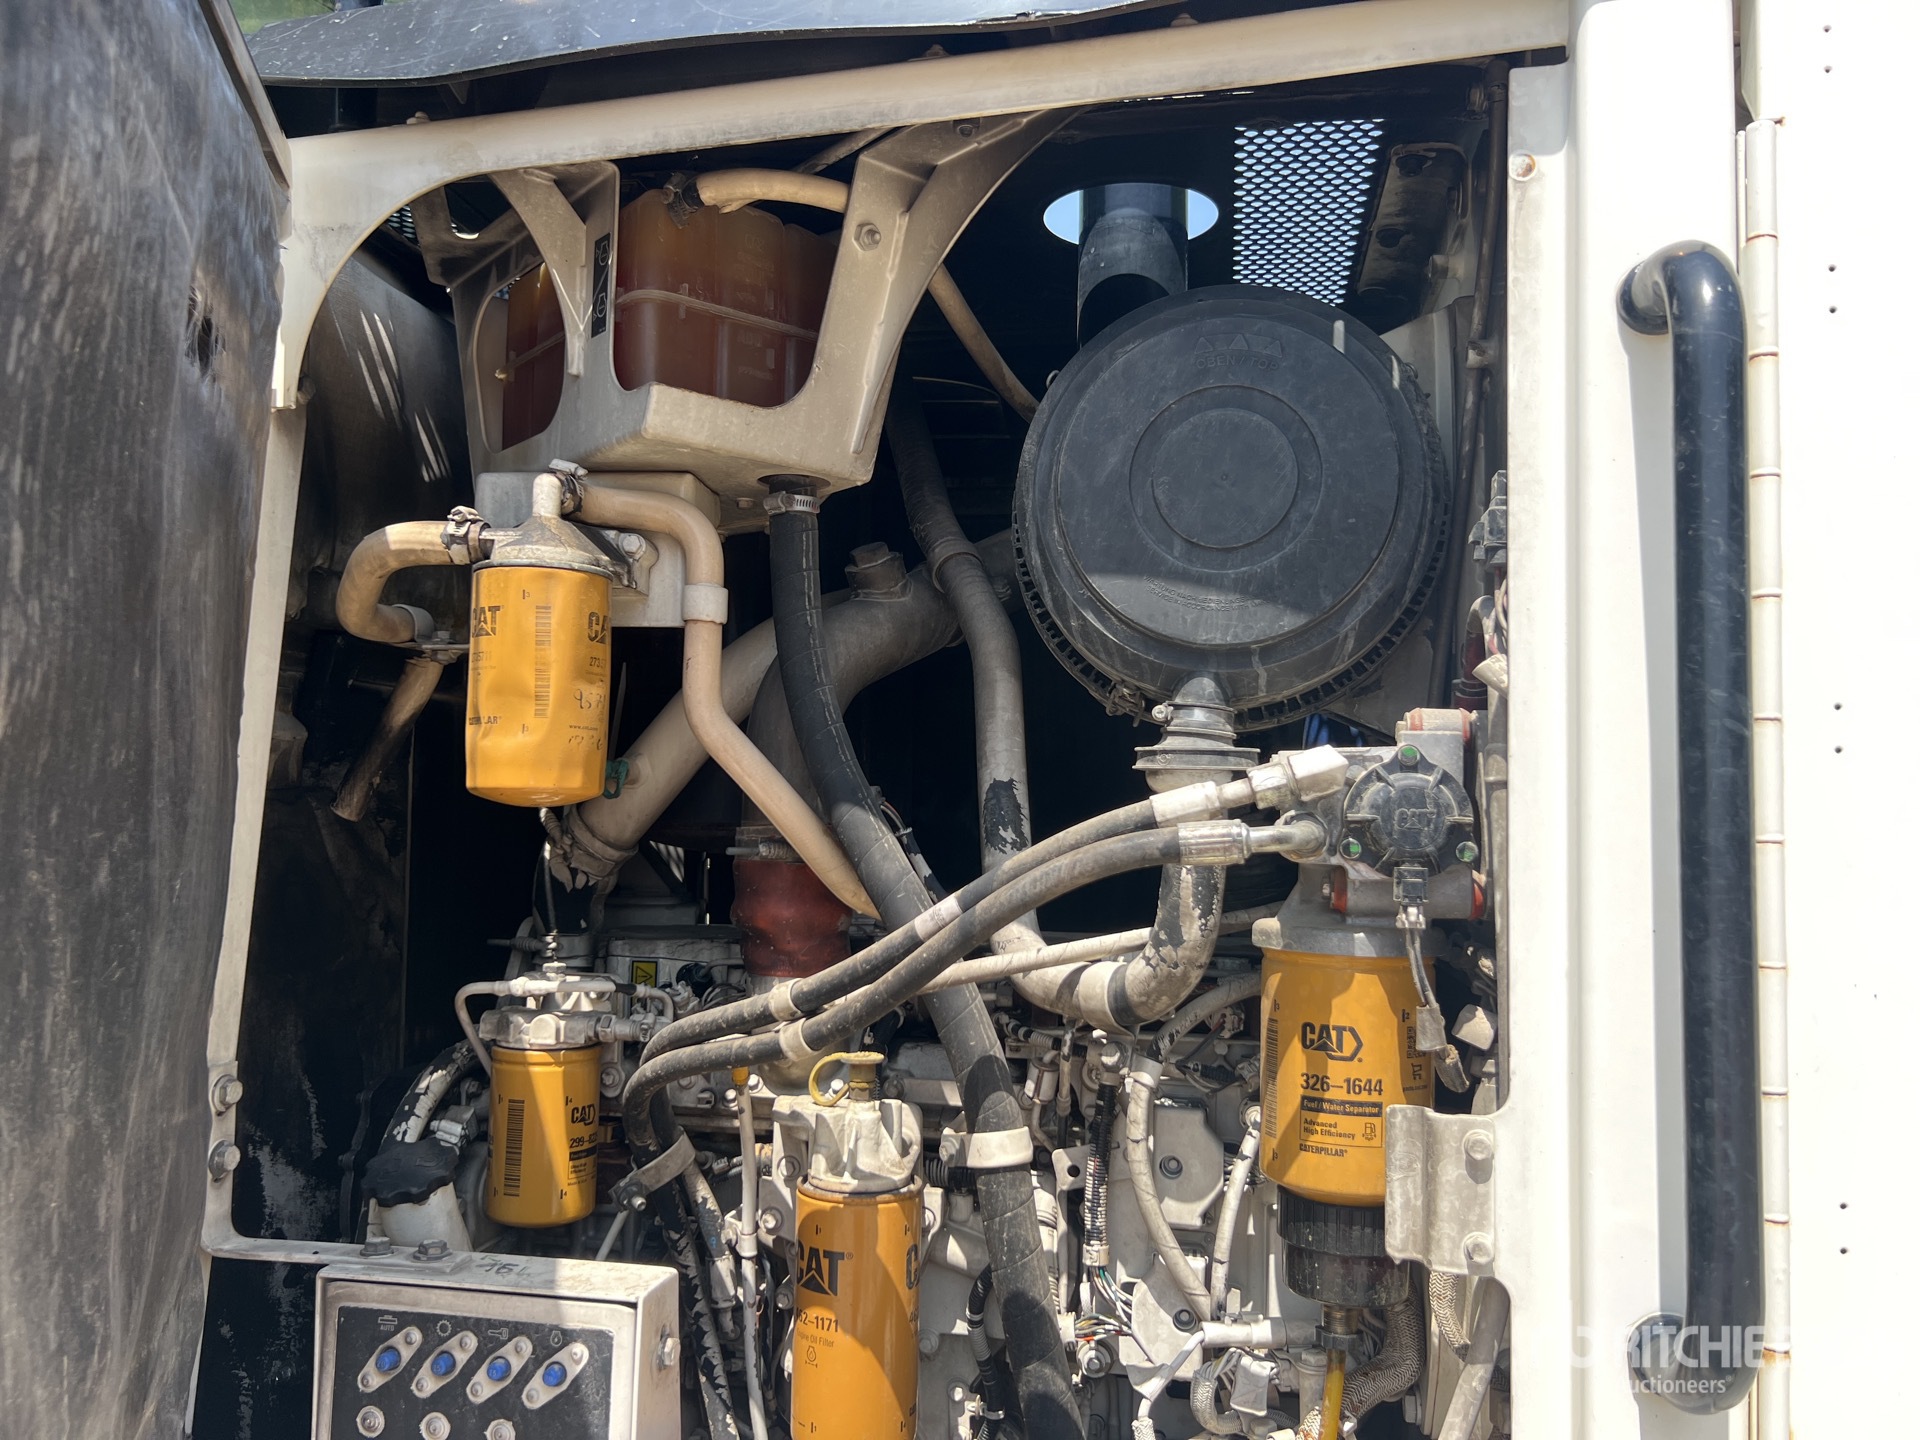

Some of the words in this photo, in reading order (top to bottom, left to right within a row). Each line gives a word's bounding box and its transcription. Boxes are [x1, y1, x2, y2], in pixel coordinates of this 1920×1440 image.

[1196, 354, 1235, 369] OBEN
[1250, 356, 1279, 369] TOP
[588, 611, 609, 644] CA
[1301, 1022, 1353, 1055] CAT
[1303, 1099, 1317, 1109] Fuel
[1322, 1101, 1343, 1111] Water
[1345, 1104, 1379, 1115] Separator
[571, 1105, 594, 1125] CAT
[1303, 1117, 1338, 1129] Advanced
[1303, 1126, 1319, 1136] High
[1320, 1128, 1356, 1140] Efficiency
[1299, 1142, 1345, 1157] CATERPILLAR
[797, 1240, 845, 1297] CAT
[380, 1324, 395, 1332] AUTO
[810, 1334, 818, 1345] Oil
[819, 1336, 834, 1348] Filter
